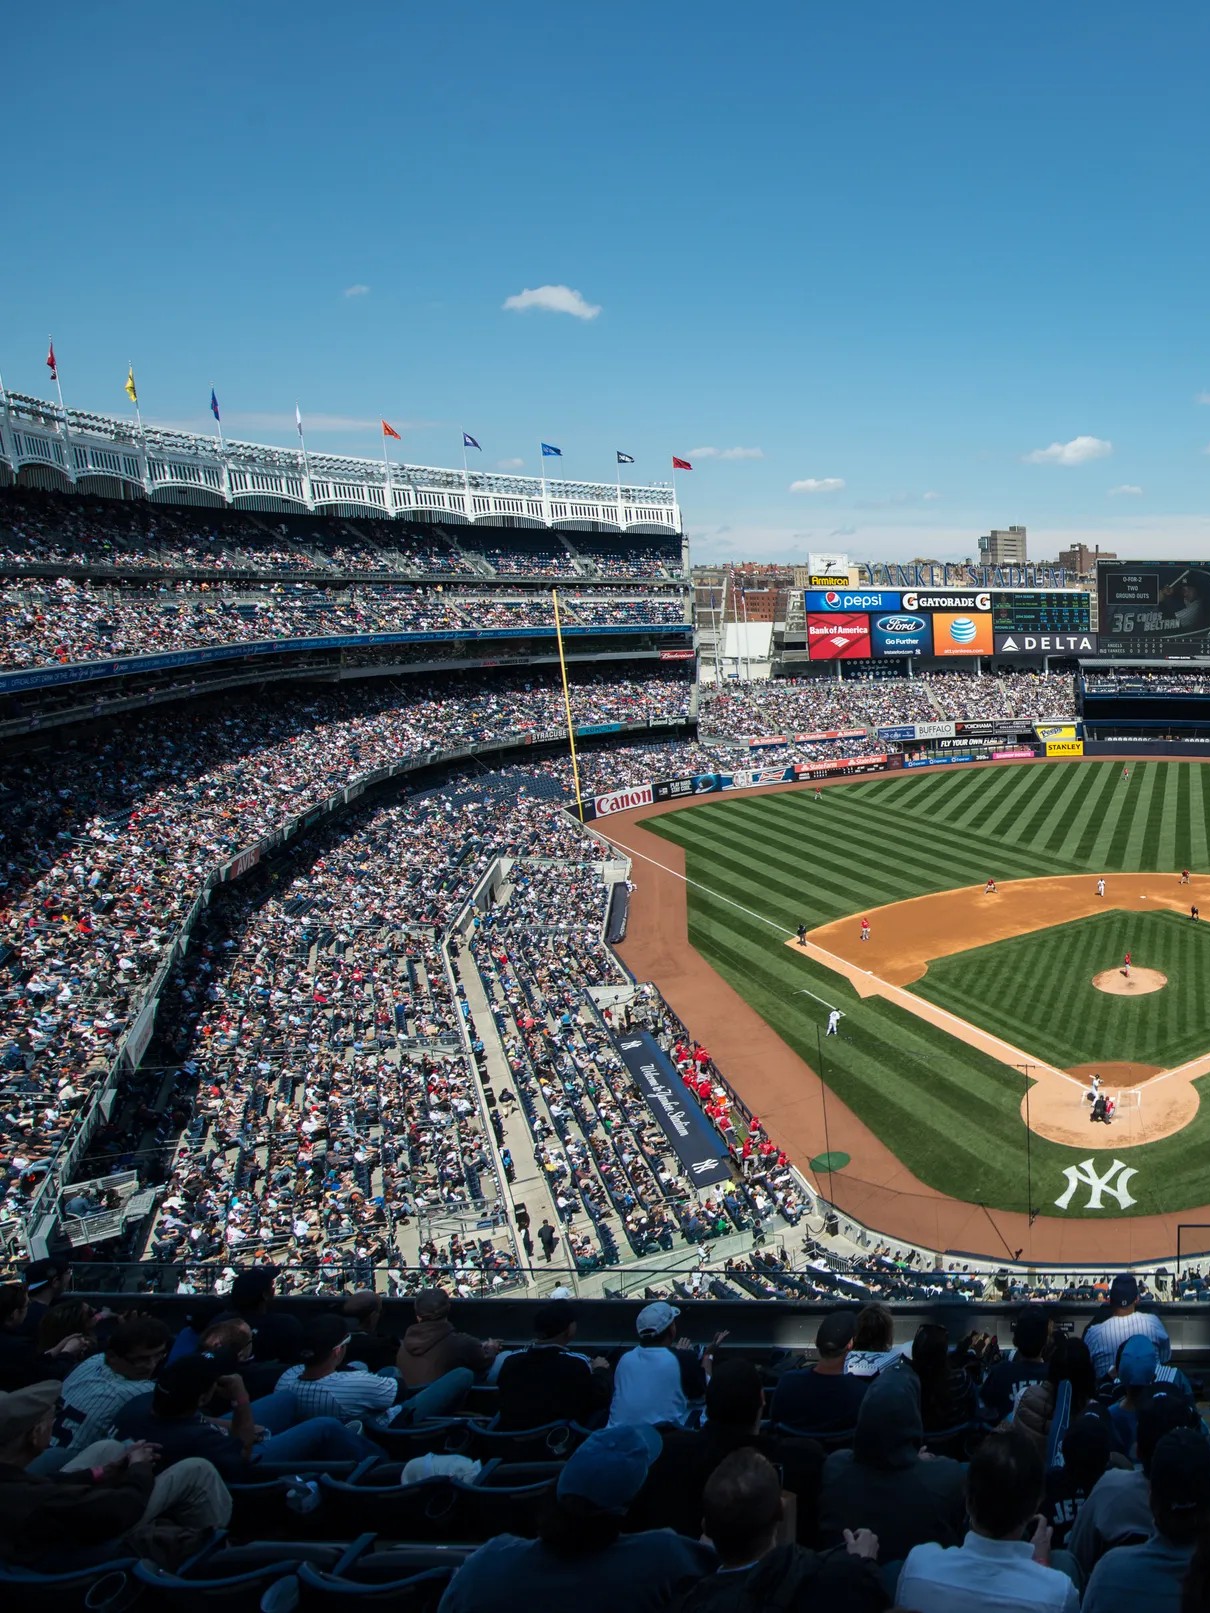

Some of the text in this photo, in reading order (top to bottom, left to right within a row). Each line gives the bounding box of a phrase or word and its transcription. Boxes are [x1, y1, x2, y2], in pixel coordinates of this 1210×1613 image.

[811, 577, 849, 586] Armitron
[866, 563, 1066, 588] YANKEE STADIUM
[844, 594, 882, 608] pepsi
[920, 598, 974, 607] GATORADE
[886, 617, 916, 631] Ford
[1112, 613, 1134, 632] 36
[810, 626, 868, 634] Bank of America
[1025, 637, 1092, 650] DELTA
[661, 652, 693, 660] Budweiser
[532, 730, 567, 740] SYRACUSE
[919, 725, 951, 734] BUFFALO
[953, 739, 968, 747] YOUR
[596, 789, 652, 814] Canon
[640, 1064, 660, 1087] Welcome
[647, 1089, 679, 1112] Yankee
[667, 1111, 690, 1137] Stadium
[1054, 1157, 1139, 1210] NY
